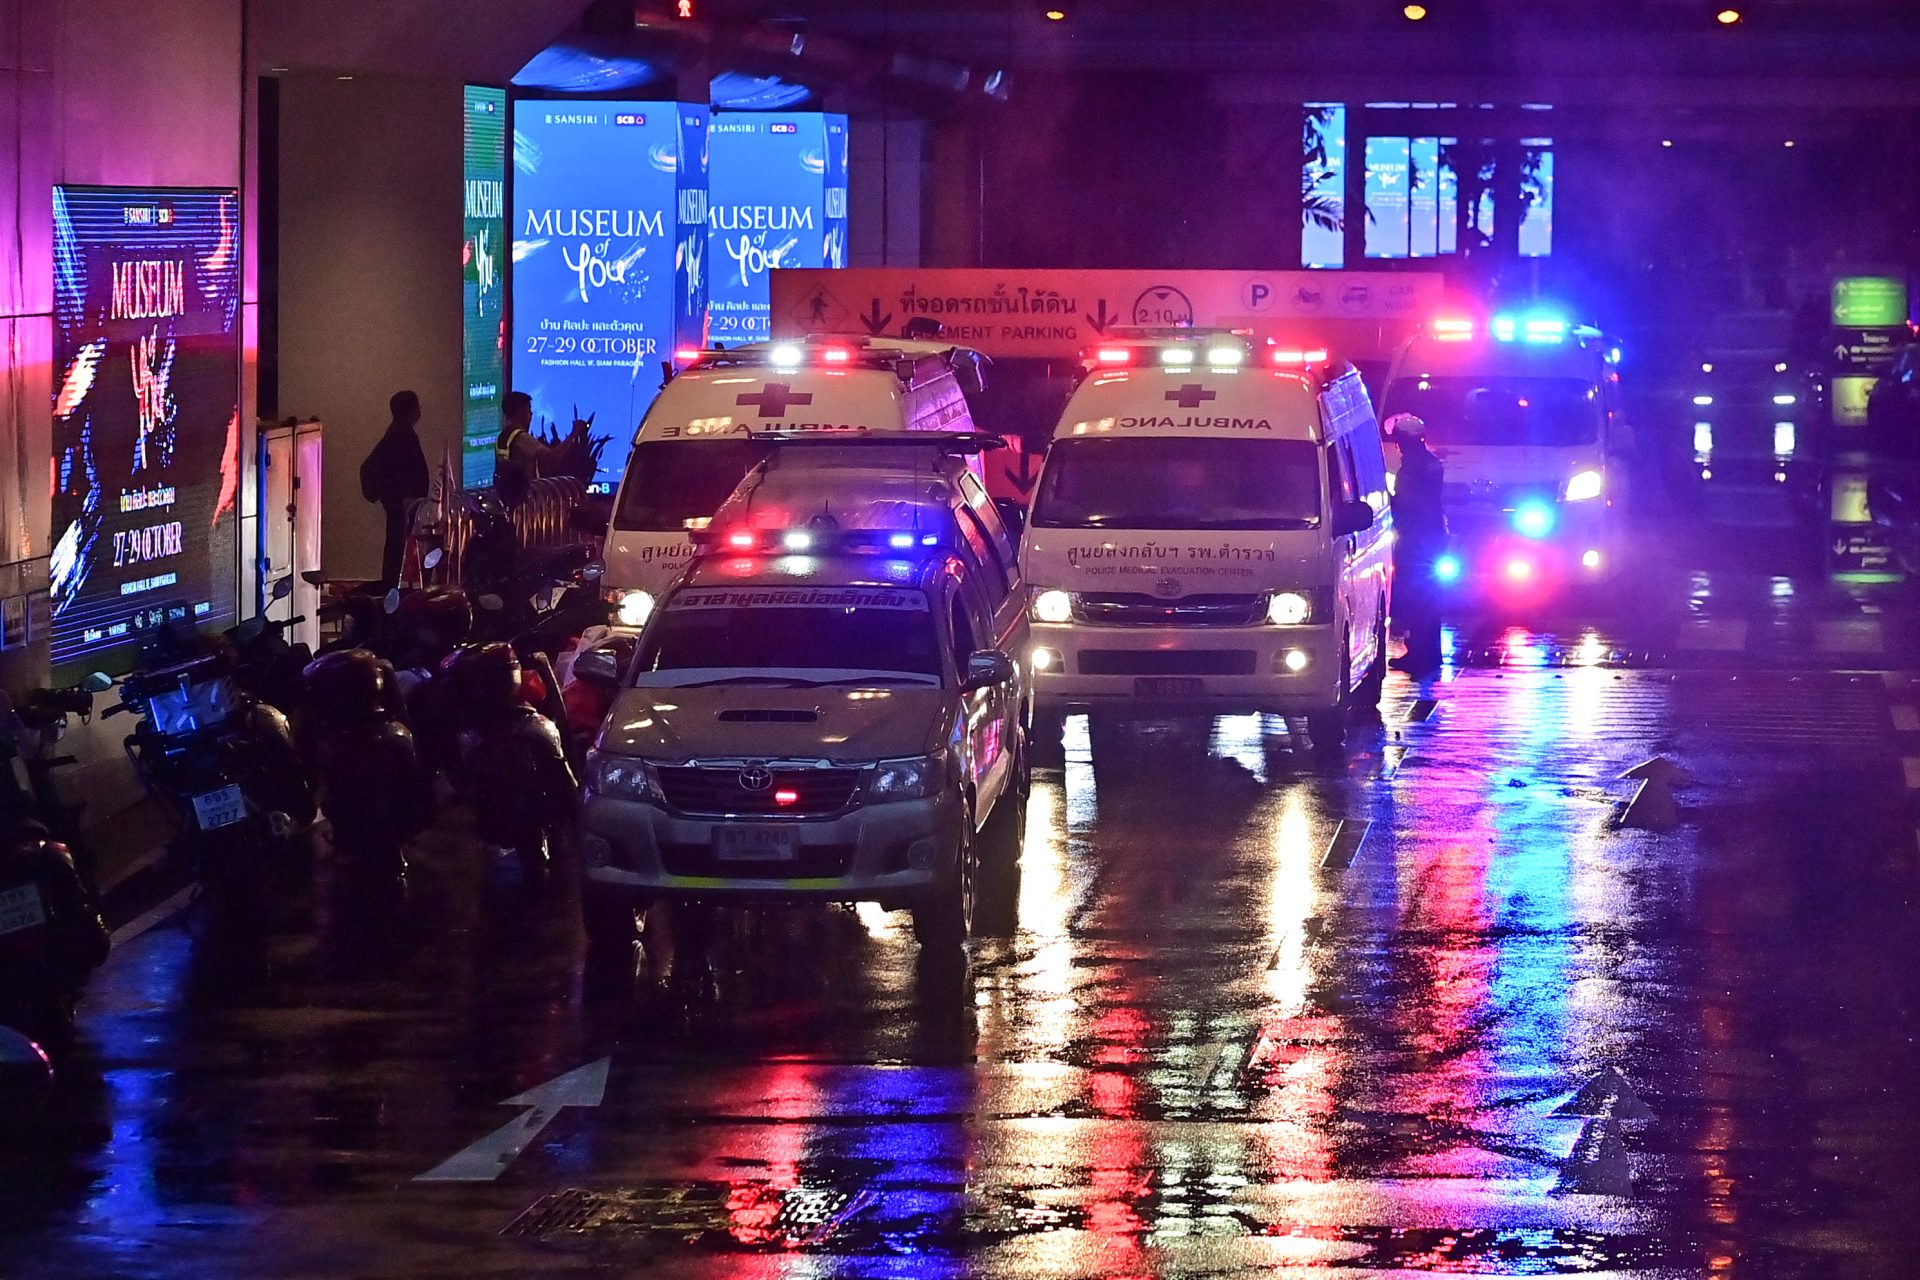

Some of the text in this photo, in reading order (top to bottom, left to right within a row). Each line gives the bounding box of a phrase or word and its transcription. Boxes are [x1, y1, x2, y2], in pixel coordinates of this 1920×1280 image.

[554, 115, 635, 124] SANSIRI SCB
[718, 124, 787, 133] SANSIRI SCB
[465, 180, 503, 219] MUSEUM
[678, 189, 707, 224] MUSEUM
[525, 209, 664, 237] MUSEUM
[594, 238, 611, 257] of
[753, 231, 767, 247] of
[725, 235, 780, 287] You
[562, 243, 626, 303] You
[111, 260, 185, 319] MUSEUM
[1251, 284, 1268, 306] P
[902, 284, 1077, 314] ที่จอดรถชั้นใต้ดิน
[540, 318, 560, 330] บ้าน
[708, 316, 770, 330] 7-29 OCT
[1139, 309, 1172, 323] 2.10
[1002, 326, 1077, 340] PARKING
[527, 337, 656, 354] 27-29 OCTOBER
[541, 359, 569, 367] FASHION
[570, 359, 586, 367] HALL
[113, 522, 182, 568] 27-29 OCTOBER
[1188, 543, 1275, 561] รพ.ตำรวจ
[1086, 566, 1116, 575] POLICE
[1160, 566, 1215, 576] EVACUATION
[1218, 567, 1253, 577] CENTER
